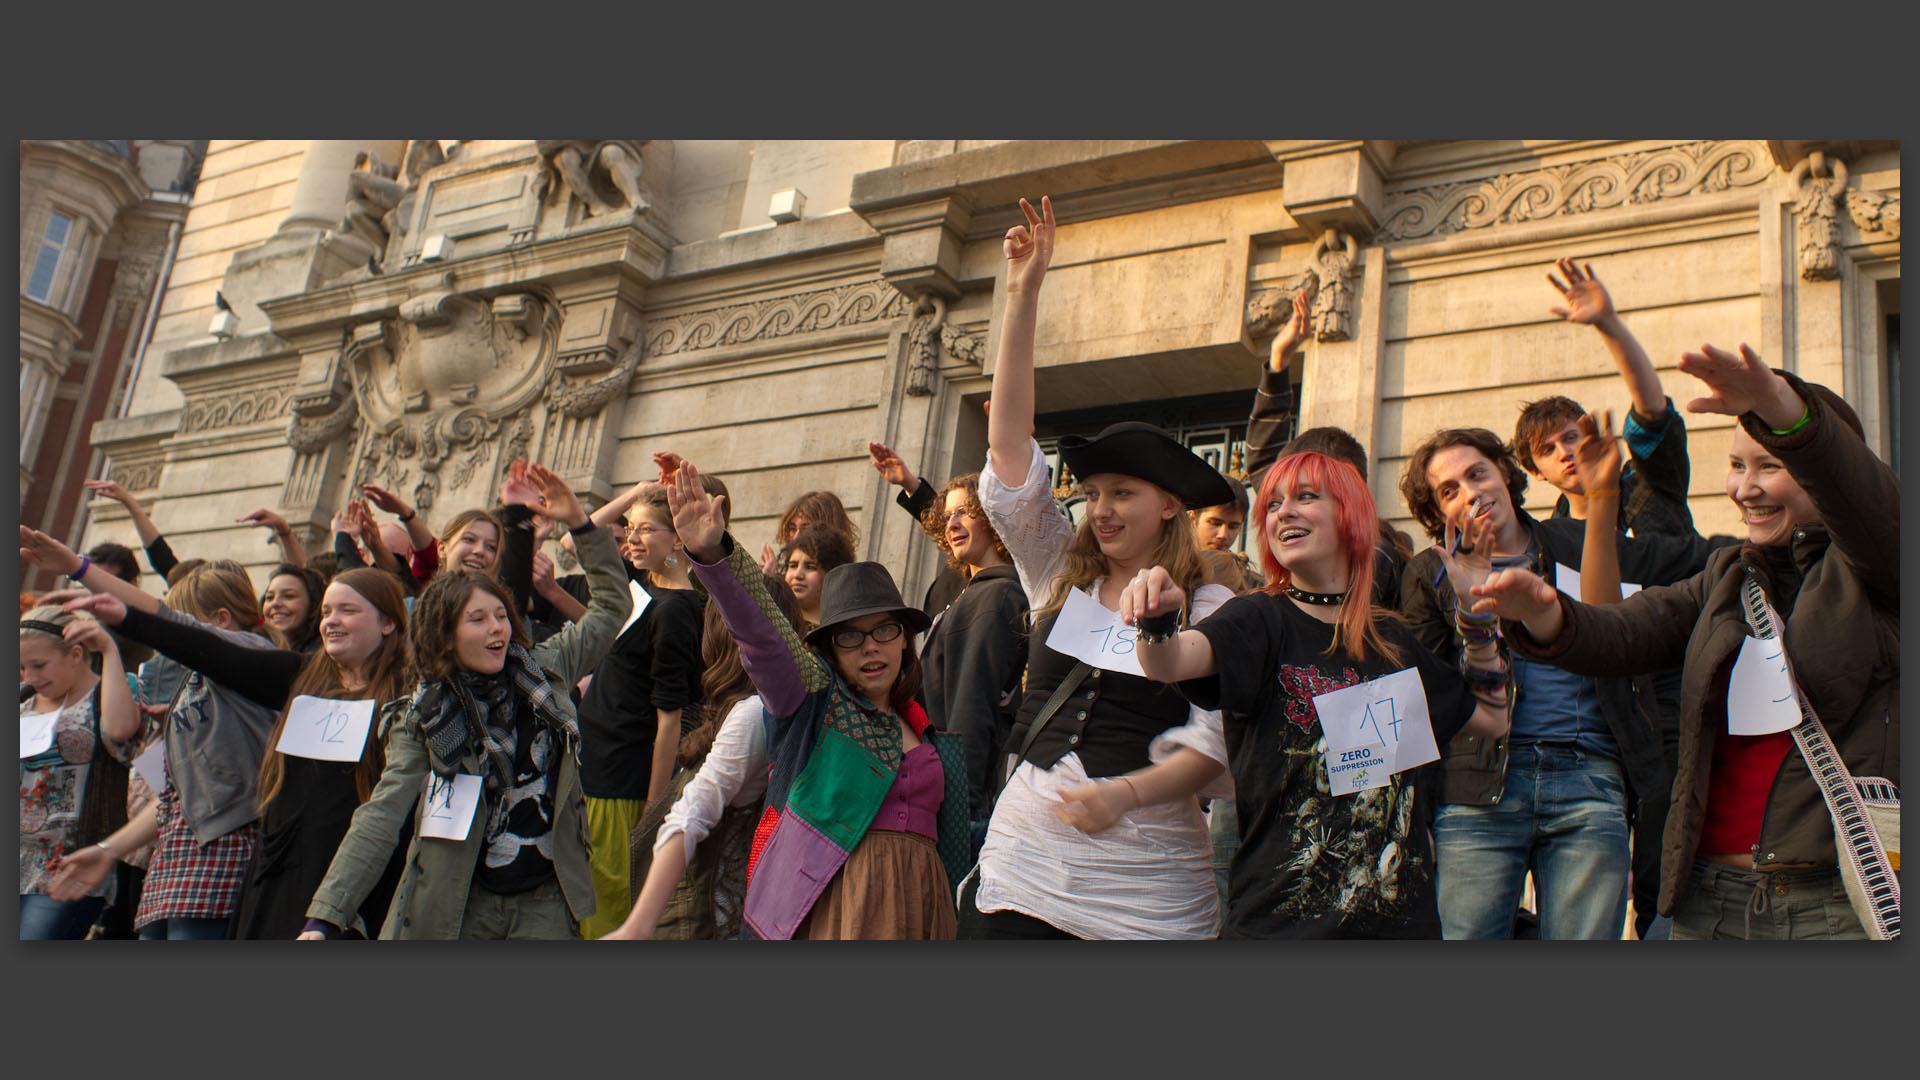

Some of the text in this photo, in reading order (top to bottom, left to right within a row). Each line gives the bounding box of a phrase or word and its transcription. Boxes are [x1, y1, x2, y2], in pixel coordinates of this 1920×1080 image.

[1090, 625, 1138, 655] 18
[315, 712, 345, 743] 12
[1360, 697, 1403, 747] 17
[1331, 757, 1384, 773] SUPPRESSION
[1340, 748, 1371, 762] ZERO
